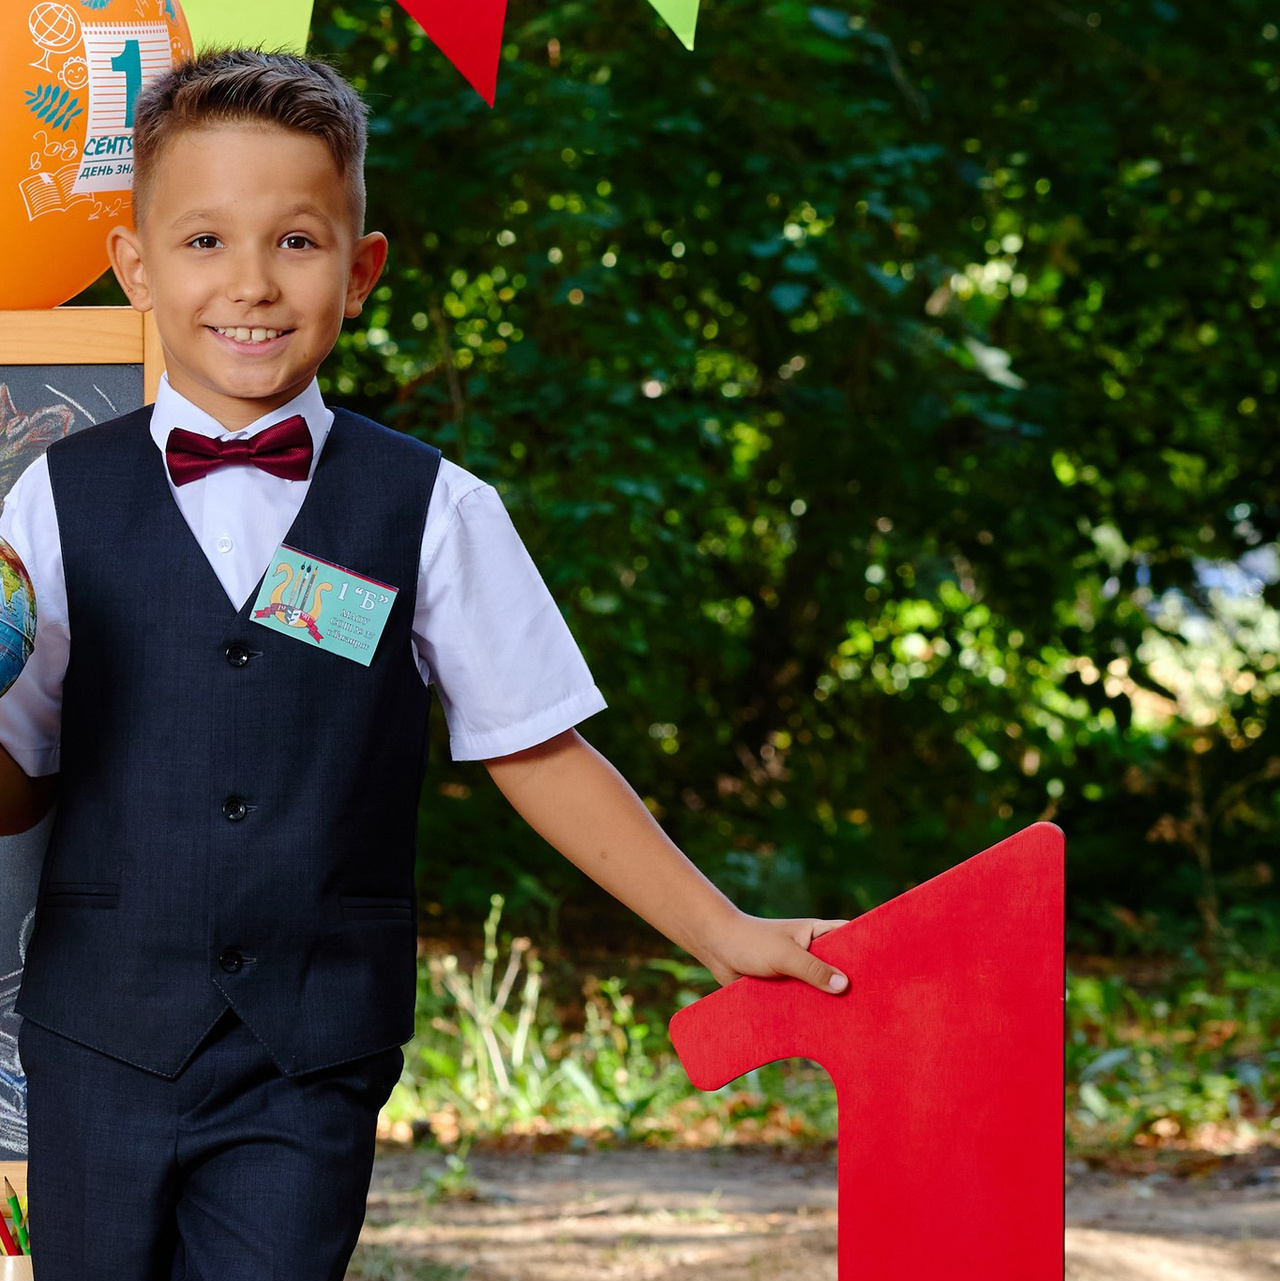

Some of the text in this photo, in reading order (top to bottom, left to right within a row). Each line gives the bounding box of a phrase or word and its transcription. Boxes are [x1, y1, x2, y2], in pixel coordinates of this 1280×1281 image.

[111, 39, 142, 128] 1
[79, 165, 114, 180] ДЕНЬ
[337, 581, 350, 601] 1
